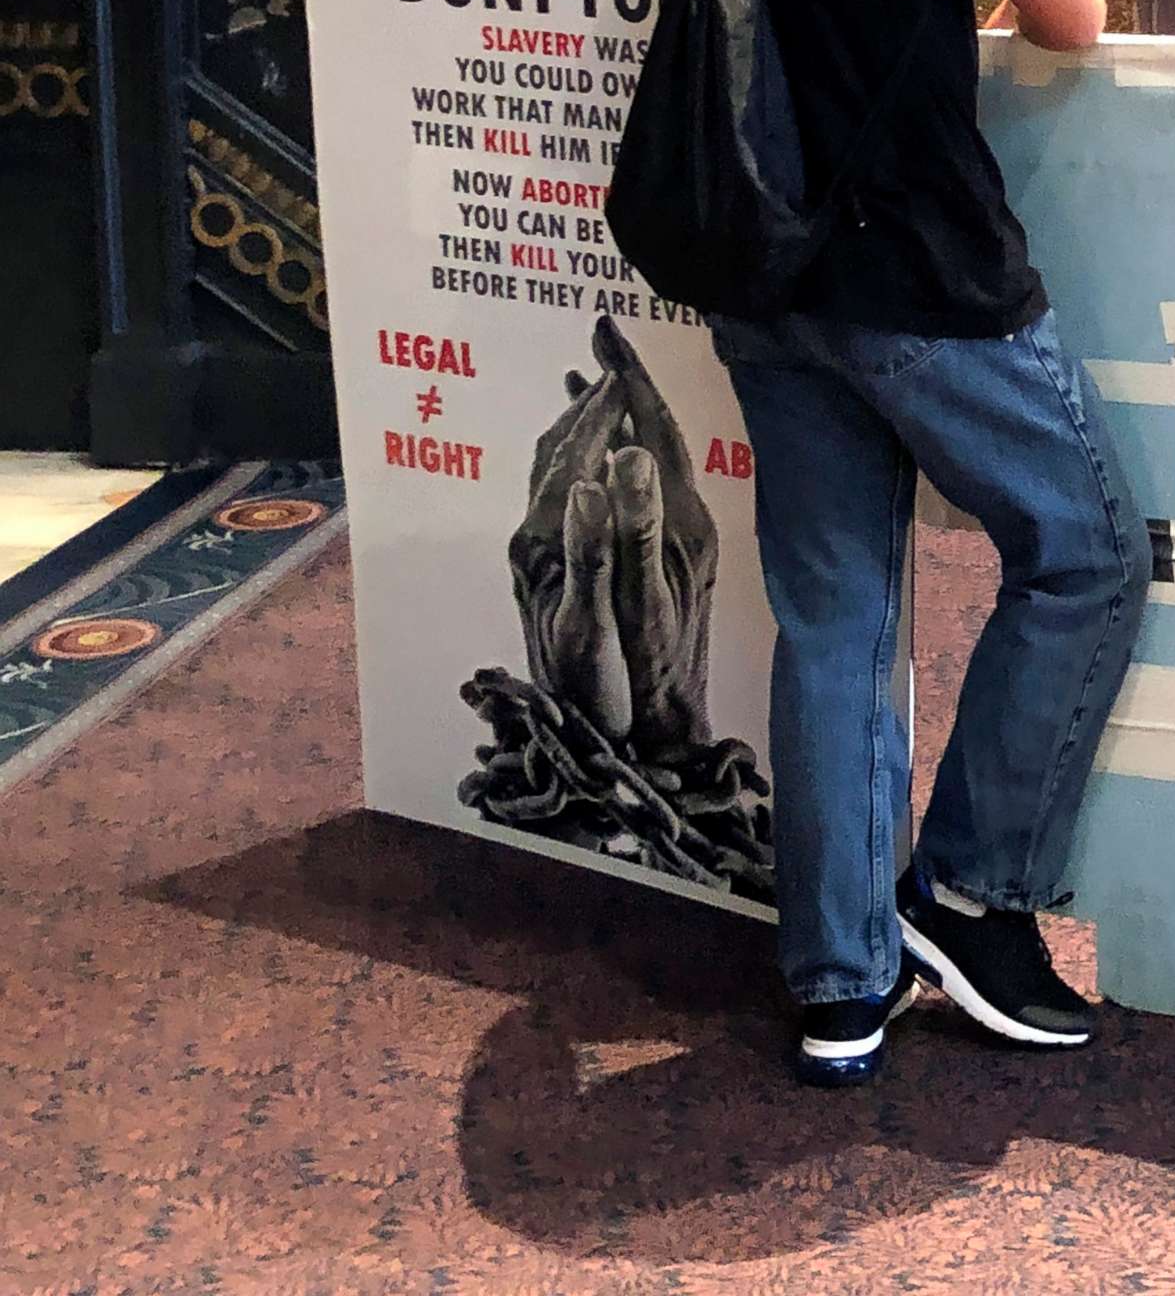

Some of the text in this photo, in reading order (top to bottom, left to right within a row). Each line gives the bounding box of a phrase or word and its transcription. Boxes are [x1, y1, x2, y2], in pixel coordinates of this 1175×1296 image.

[481, 24, 649, 65] SLAVERY WAS
[455, 56, 505, 86] YOU
[514, 62, 593, 94] COULD
[412, 86, 622, 132] WORK THAT MAN
[411, 119, 474, 150] THEN
[483, 127, 532, 157] KILL
[540, 133, 591, 164] HIM
[452, 168, 512, 199] NOW
[458, 202, 605, 245] YOU CAN BE
[438, 233, 635, 283] THEN KILL YOUR
[431, 265, 518, 301] BEFORE
[525, 278, 584, 310] THEY
[594, 288, 640, 318] ARE
[377, 329, 477, 378] LEGAL
[384, 430, 484, 482] RIGHT
[704, 436, 753, 480] AB
